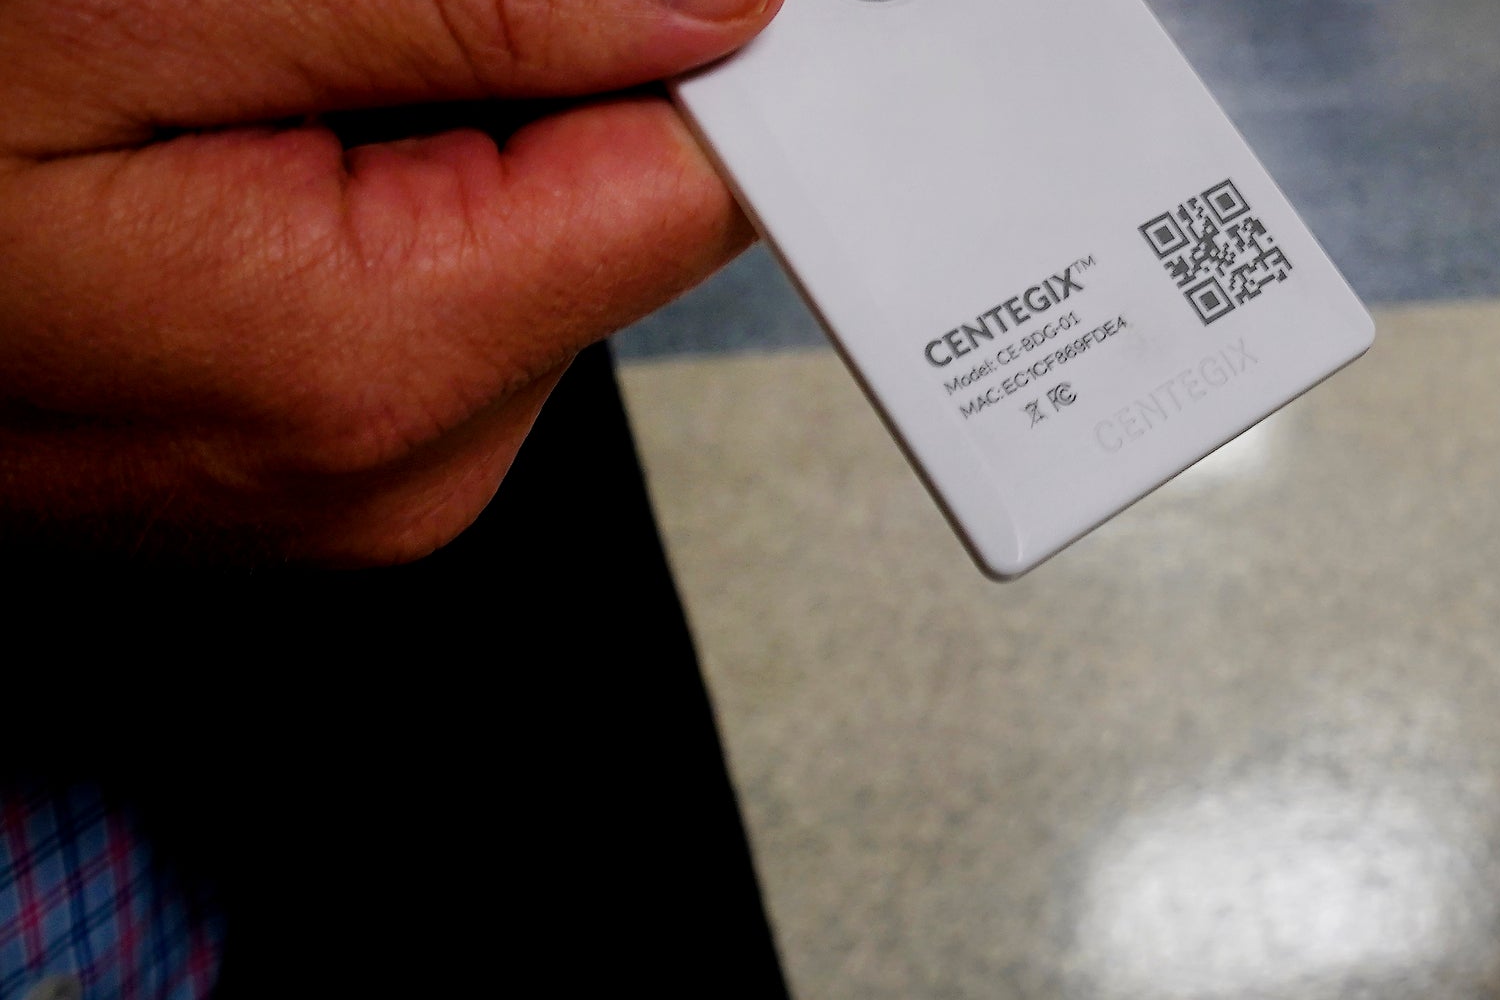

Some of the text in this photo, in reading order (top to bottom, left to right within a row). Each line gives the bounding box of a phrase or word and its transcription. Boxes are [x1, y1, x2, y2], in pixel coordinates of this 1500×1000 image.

[943, 311, 1082, 396] Model: CE-BDG-01
[1094, 337, 1259, 452] CENTEGIX
